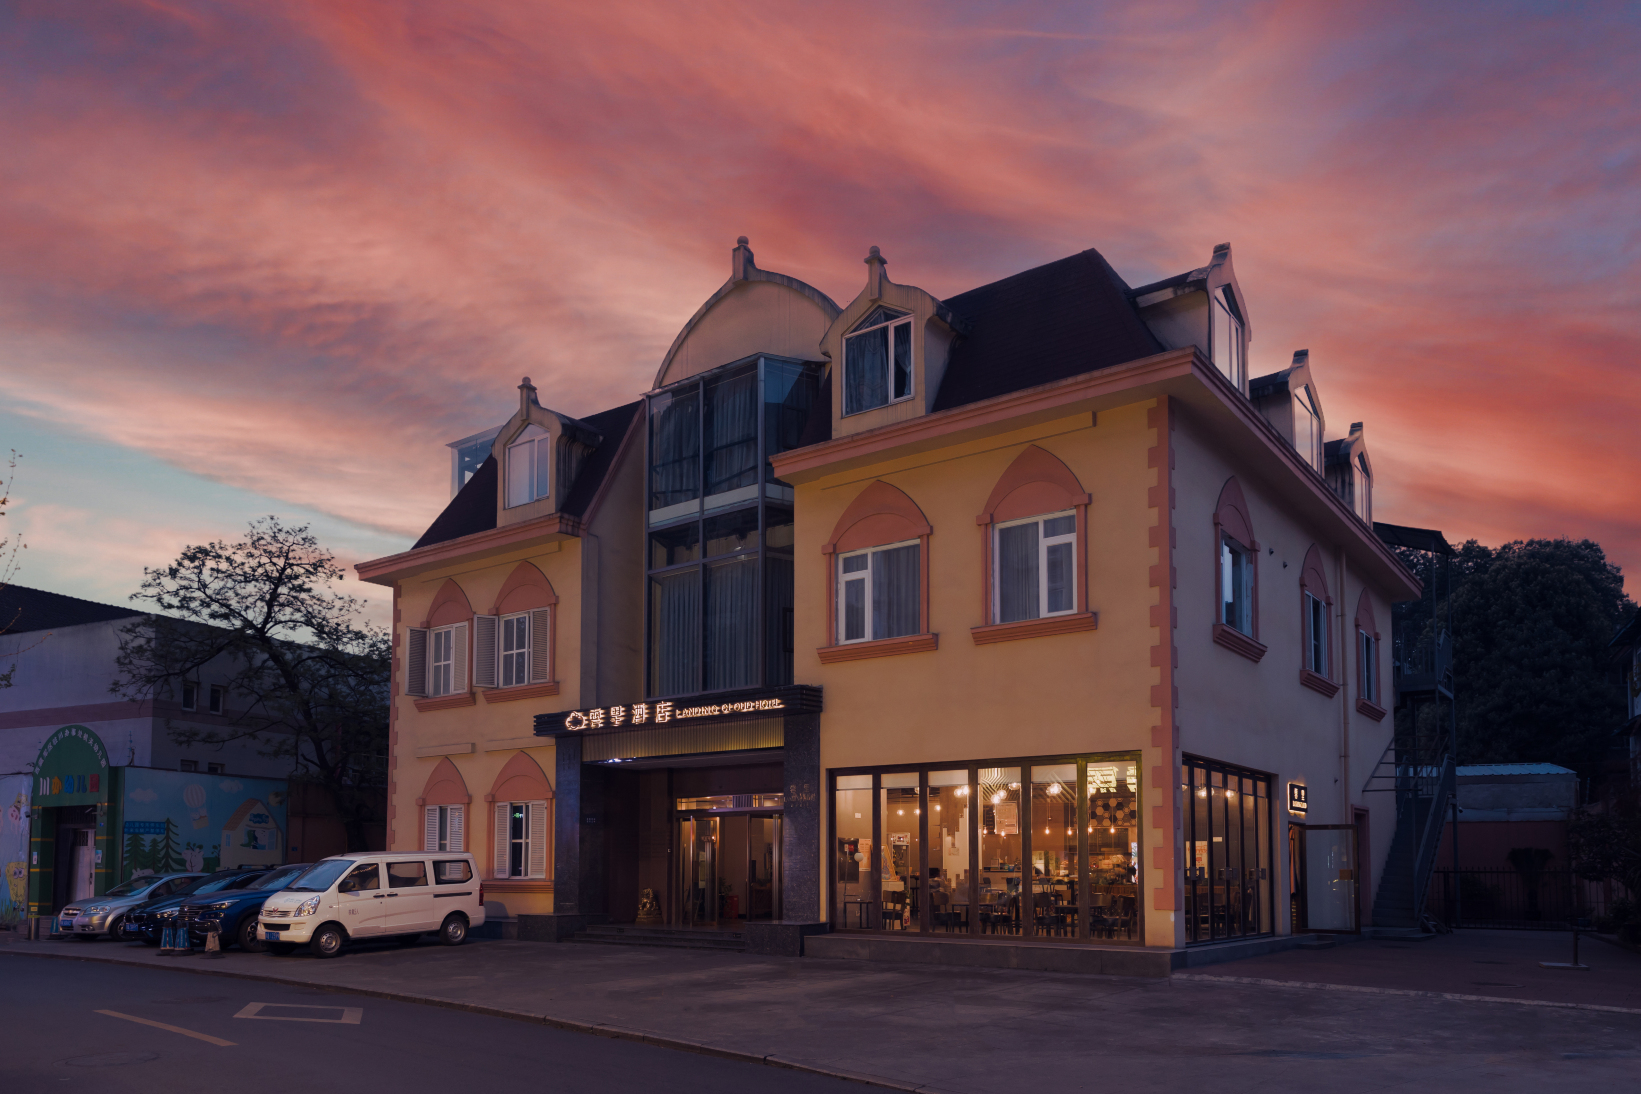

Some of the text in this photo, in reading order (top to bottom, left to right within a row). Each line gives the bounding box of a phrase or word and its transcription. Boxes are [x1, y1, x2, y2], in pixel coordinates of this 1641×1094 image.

[675, 704, 719, 719] LANDING
[39, 773, 100, 796] 川办幼儿园
